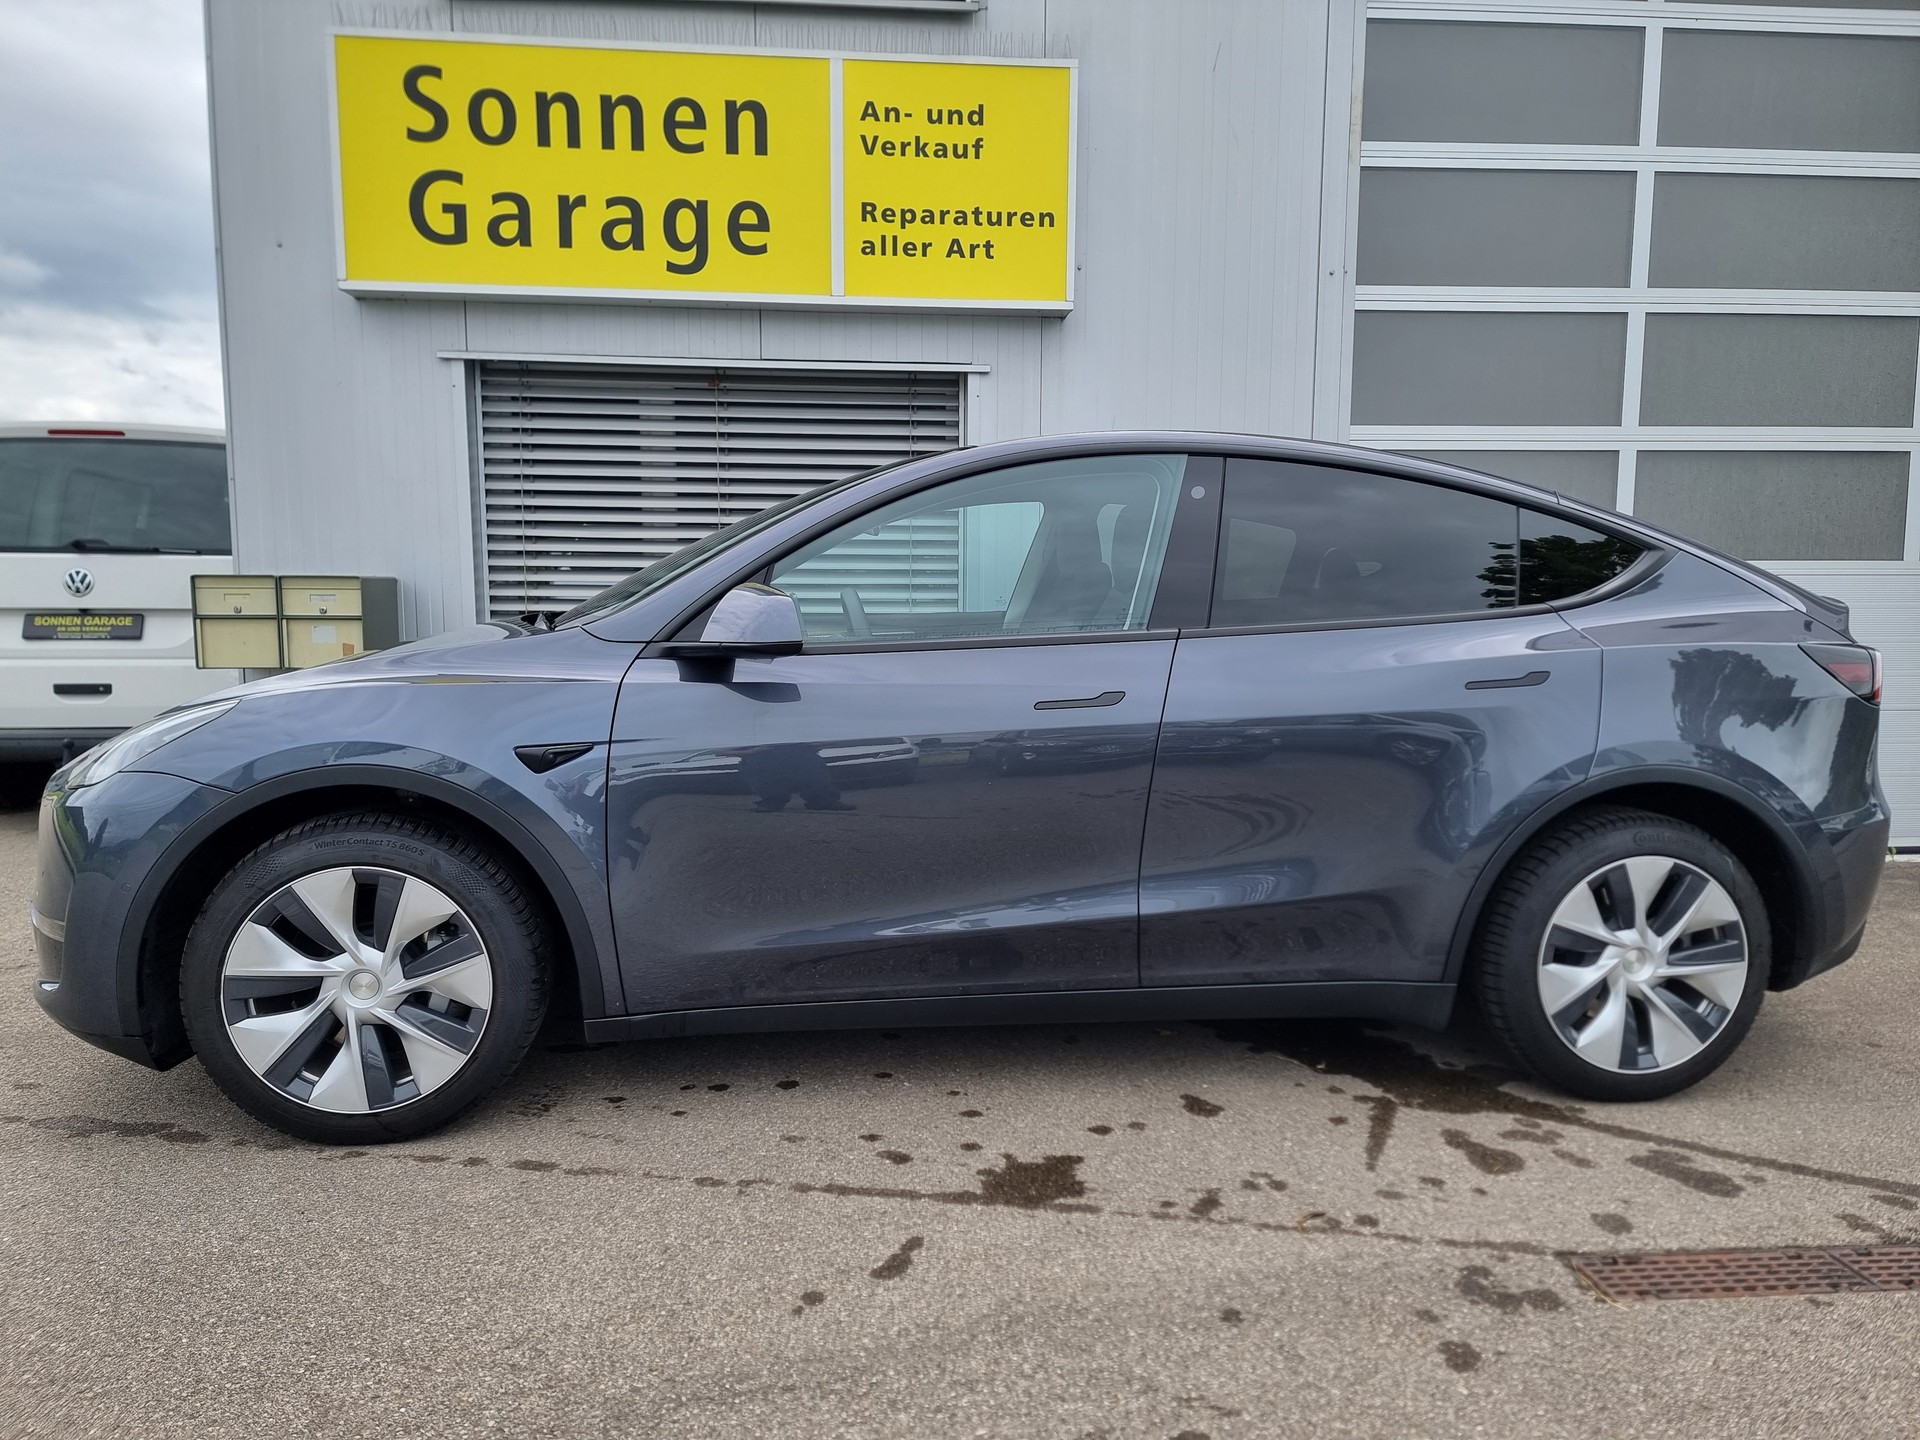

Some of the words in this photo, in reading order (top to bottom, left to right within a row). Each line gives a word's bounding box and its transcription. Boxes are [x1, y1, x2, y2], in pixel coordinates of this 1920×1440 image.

[403, 64, 769, 157] Sonnen
[860, 100, 913, 123] An-
[927, 103, 985, 127] und
[860, 134, 985, 160] Verkauf
[408, 169, 771, 275] Garage
[861, 201, 1056, 230] Reparaturen
[860, 234, 933, 258] aller
[945, 238, 995, 260] Art
[34, 616, 81, 626] SONNEN
[84, 616, 133, 626] GARAGE
[399, 843, 417, 854] 860
